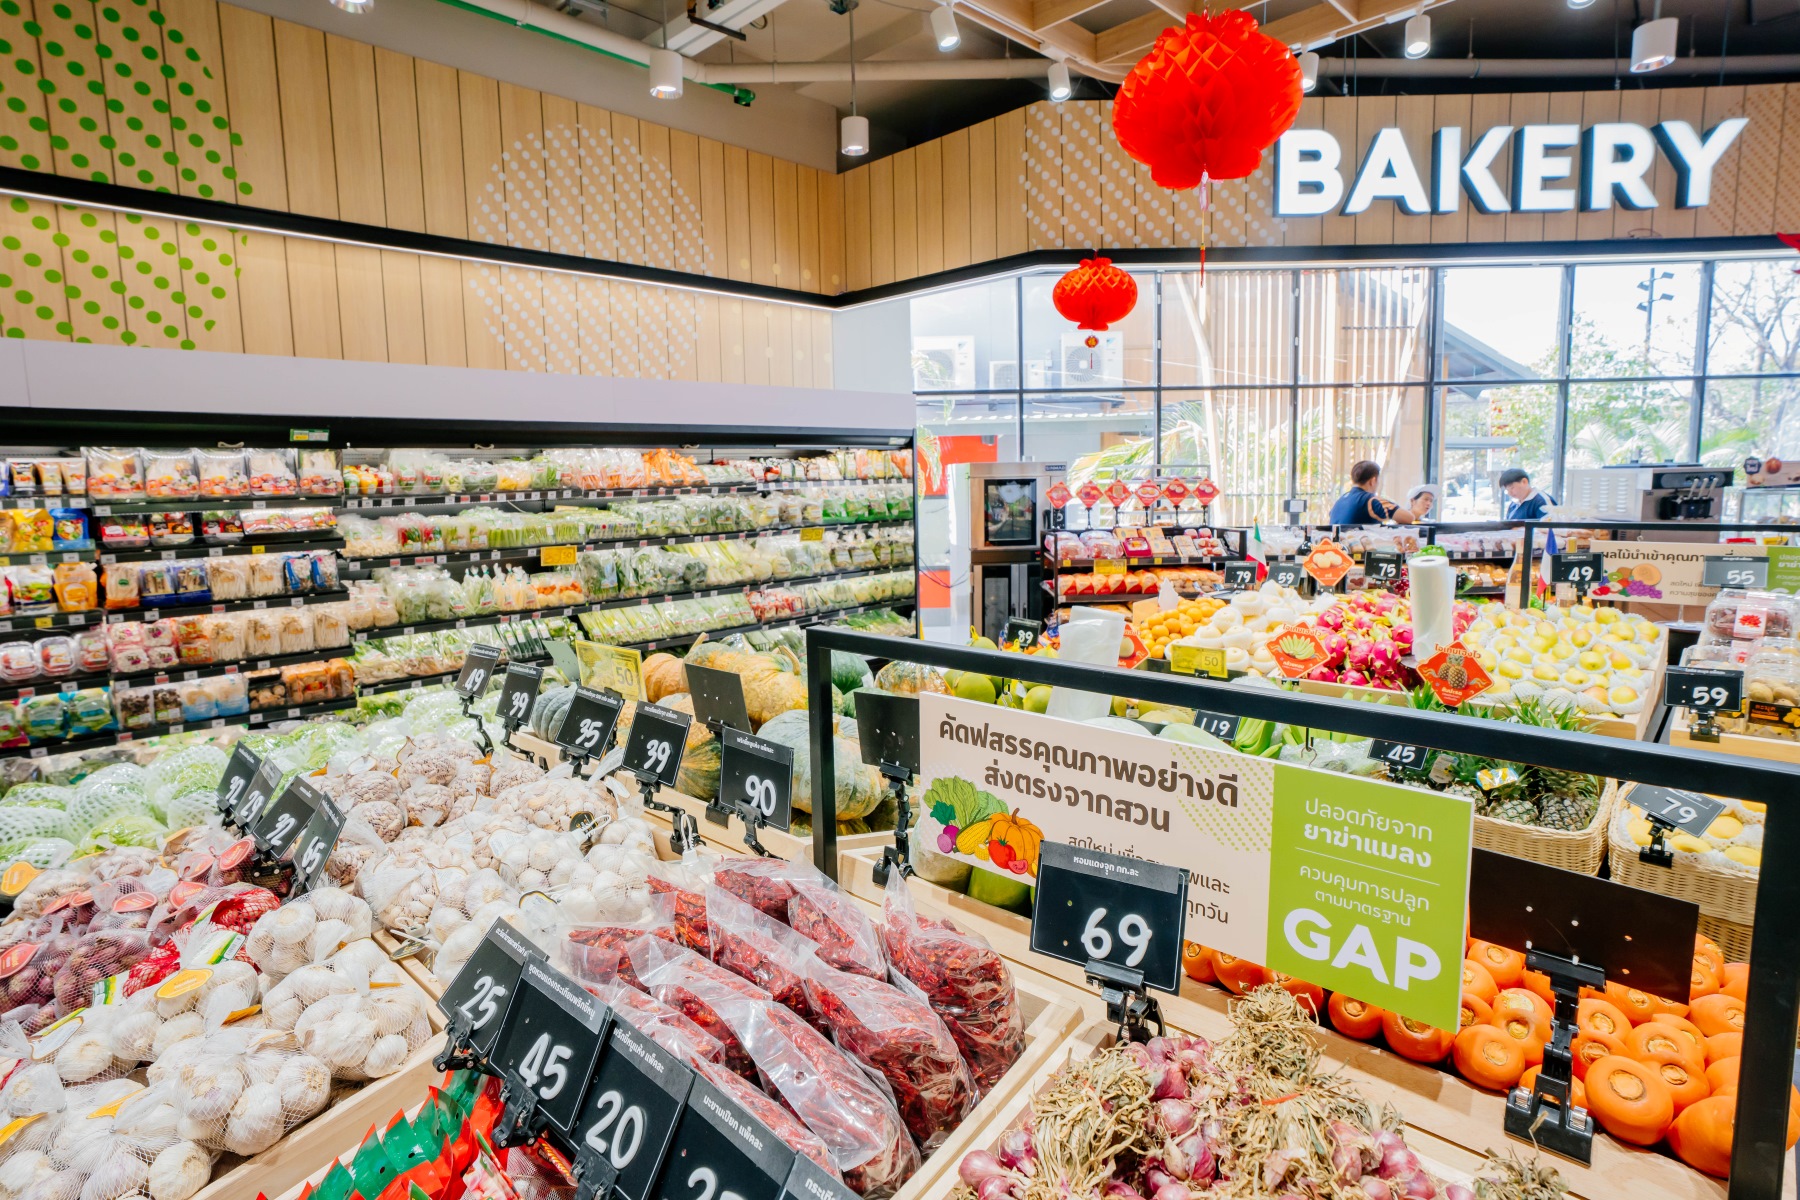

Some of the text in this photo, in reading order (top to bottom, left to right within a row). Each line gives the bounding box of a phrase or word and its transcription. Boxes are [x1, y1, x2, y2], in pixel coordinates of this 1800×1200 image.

[1275, 118, 1749, 216] BAKERY
[1236, 571, 1251, 583] 79
[1277, 572, 1295, 585] 59
[1379, 563, 1396, 577] 75
[1568, 566, 1594, 582] 49
[1726, 570, 1755, 585] 55
[1018, 629, 1033, 644] 89
[1204, 656, 1218, 667] 50
[464, 668, 486, 691] 49
[615, 666, 633, 686] 50
[509, 691, 529, 718] 39
[1692, 686, 1729, 706] 59
[575, 718, 603, 748] 35
[1200, 717, 1230, 735] 119
[643, 739, 671, 773] 39
[1387, 745, 1415, 763] 45
[745, 774, 776, 817] 90
[984, 758, 1170, 832] ส่งตรงจากสวน
[1305, 798, 1433, 842] ปลอดภัยจาก
[1661, 796, 1698, 824] 79
[1304, 823, 1432, 868] ยาฆ่าแมลง
[1116, 865, 1140, 877] กก.ละ
[1300, 865, 1430, 912] ควบคุมการปลูก
[1315, 890, 1411, 926] ตามมาตรฐาน
[1081, 907, 1152, 967] 69
[1284, 908, 1442, 991] GAP
[460, 975, 507, 1030] 25
[519, 1031, 573, 1100] 45
[585, 1090, 644, 1169] 20
